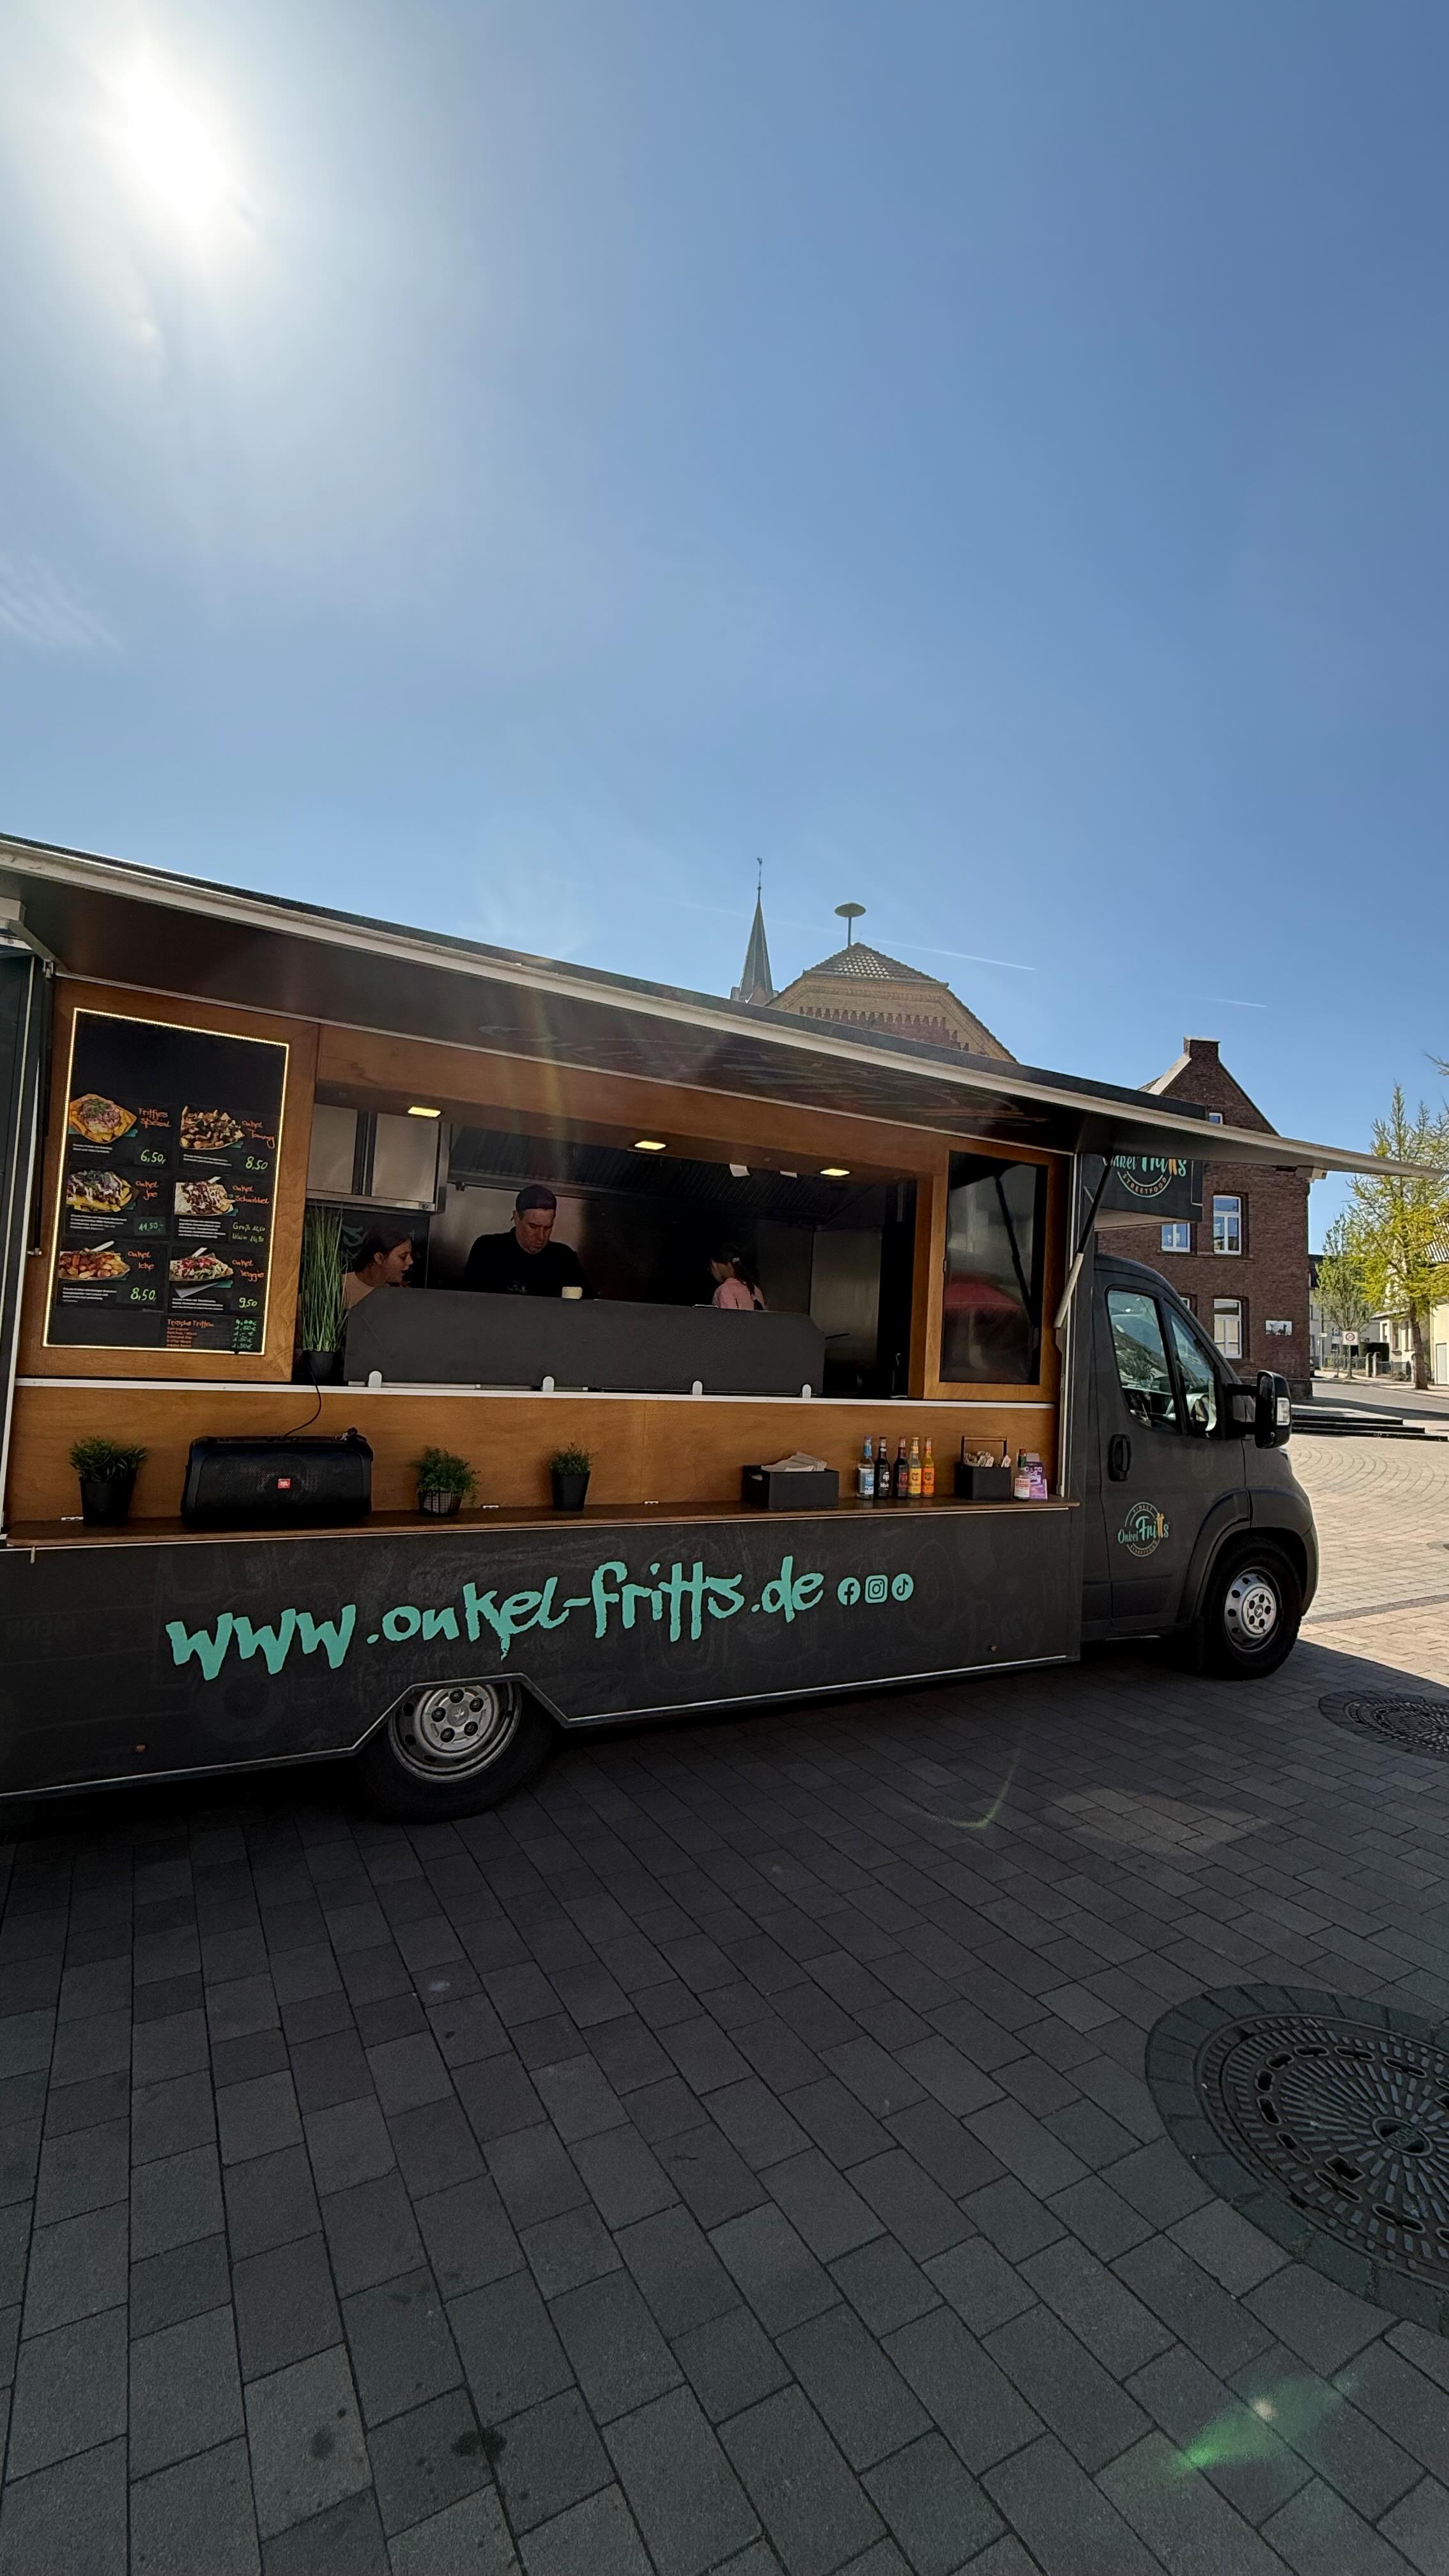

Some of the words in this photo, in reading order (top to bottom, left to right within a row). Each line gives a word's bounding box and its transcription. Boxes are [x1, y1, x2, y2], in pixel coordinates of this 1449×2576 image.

[241, 1120, 263, 1129] Onkel
[247, 1128, 275, 1149] Tommy
[245, 1156, 268, 1170] 8,50
[135, 1181, 159, 1189] Onkel
[232, 1184, 255, 1193] Onkel
[1123, 1174, 1167, 1194] STREETFOOD
[143, 1190, 158, 1200] Joe
[233, 1222, 250, 1232] Groß
[128, 1250, 152, 1259] Onkel
[231, 1259, 254, 1268] Onkel
[238, 1297, 258, 1309] 9,50
[1118, 1529, 1138, 1544] Onkel
[1135, 1512, 1169, 1541] Fritts
[166, 1556, 822, 1681] www.onkel-fritts.de
